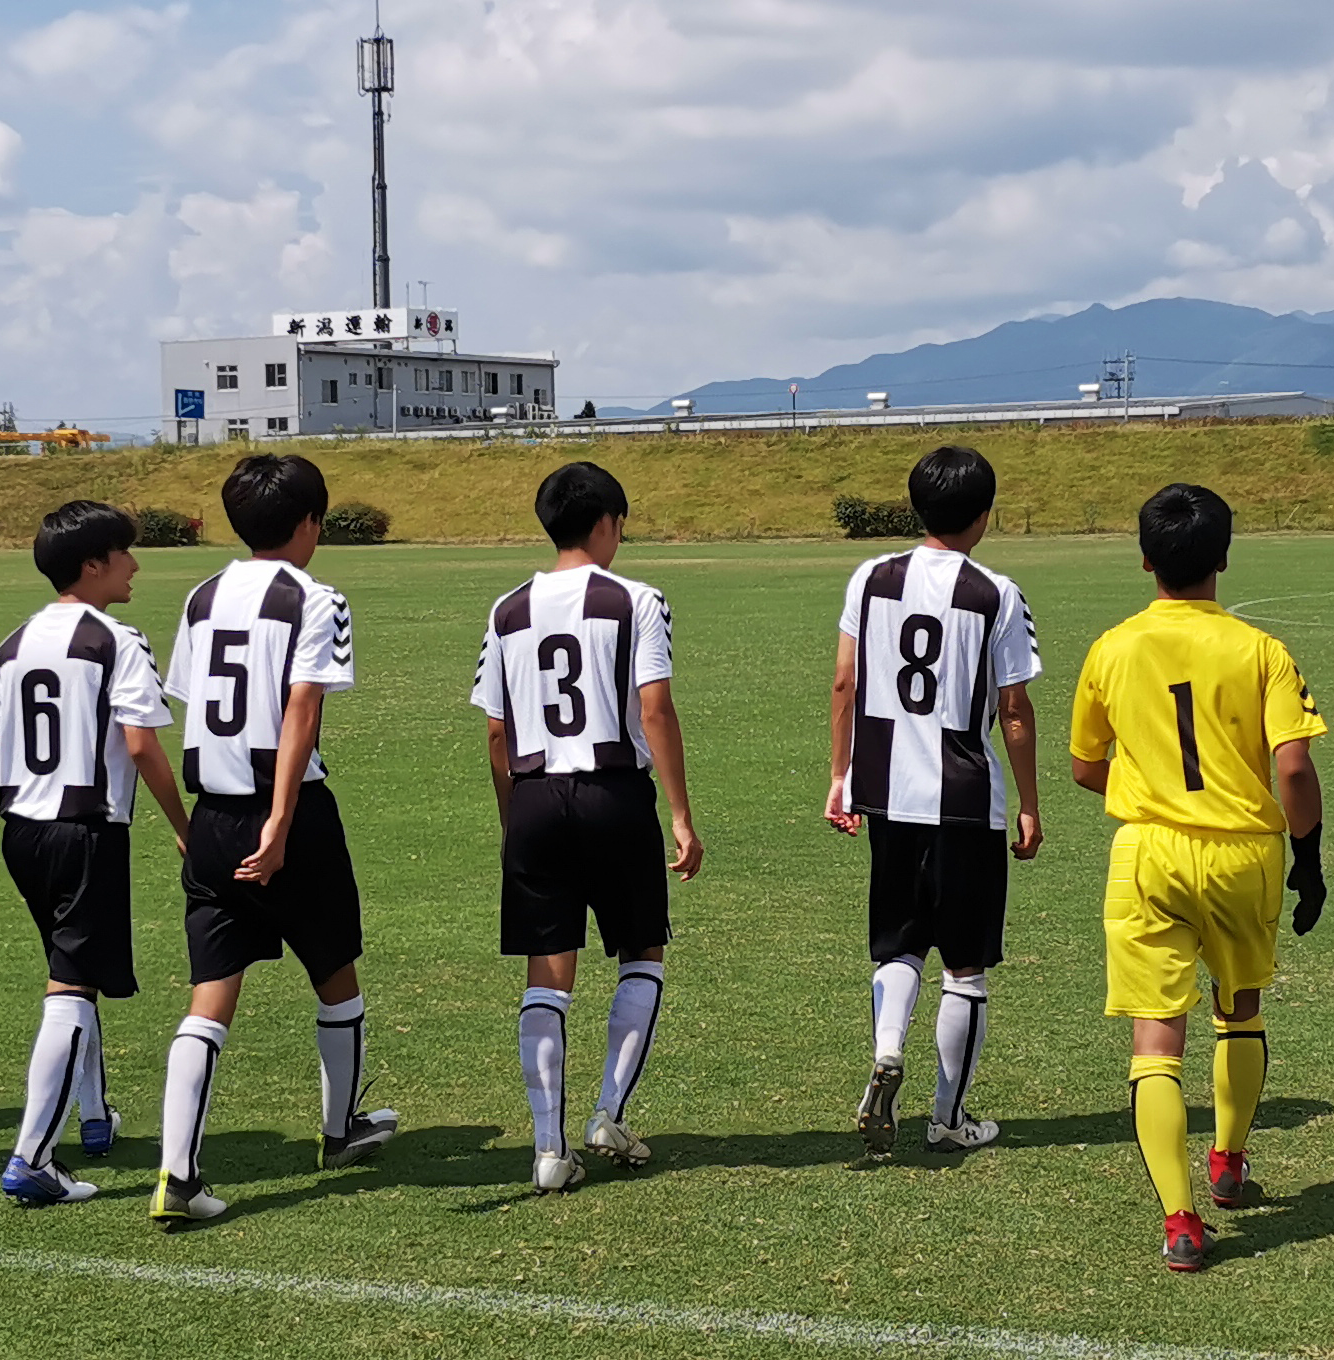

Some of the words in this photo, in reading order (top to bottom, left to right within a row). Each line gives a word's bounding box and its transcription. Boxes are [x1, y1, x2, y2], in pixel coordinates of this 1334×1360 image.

[287, 313, 393, 338] 新潟運輸
[205, 629, 249, 737] 5
[537, 633, 587, 738] 3
[896, 613, 944, 716] 8
[20, 668, 61, 776] 6
[1168, 680, 1205, 792] 1
